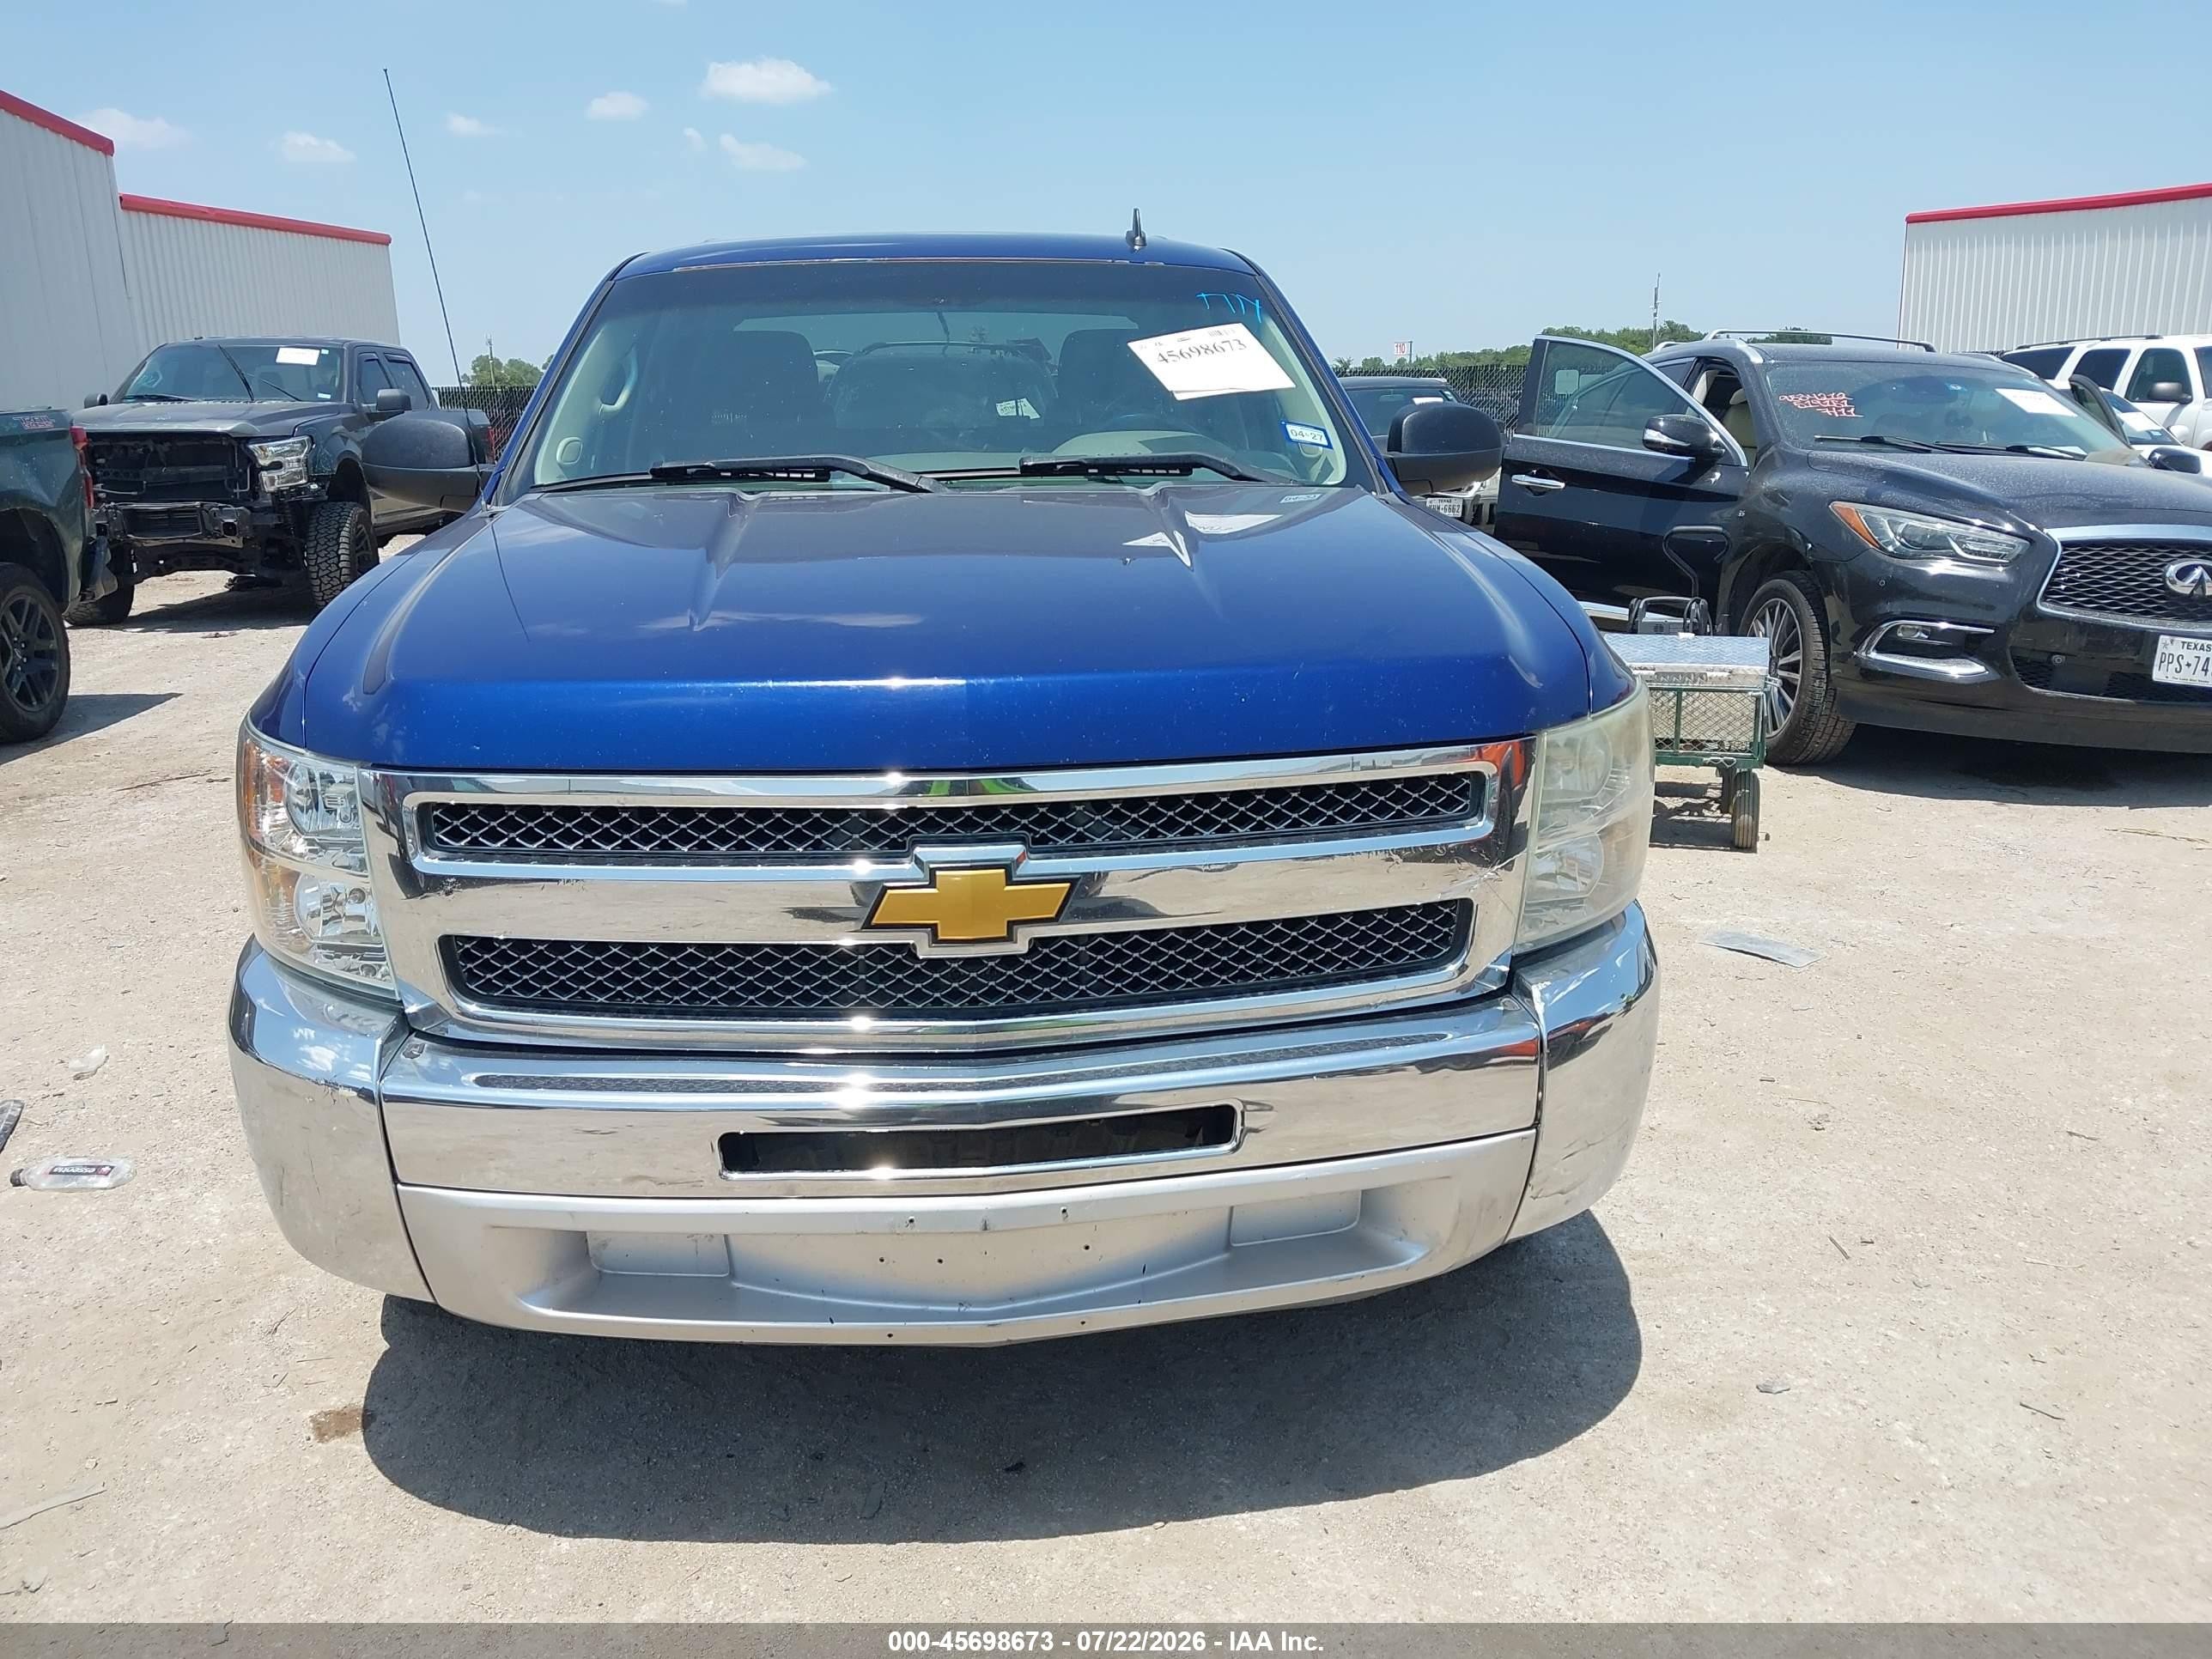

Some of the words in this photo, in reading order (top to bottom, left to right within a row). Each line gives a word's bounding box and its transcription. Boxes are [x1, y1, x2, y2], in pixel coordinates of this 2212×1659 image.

[1158, 338, 1247, 363] 45698673
[1395, 343, 1405, 354] 110
[2181, 641, 2212, 653] TEXAS
